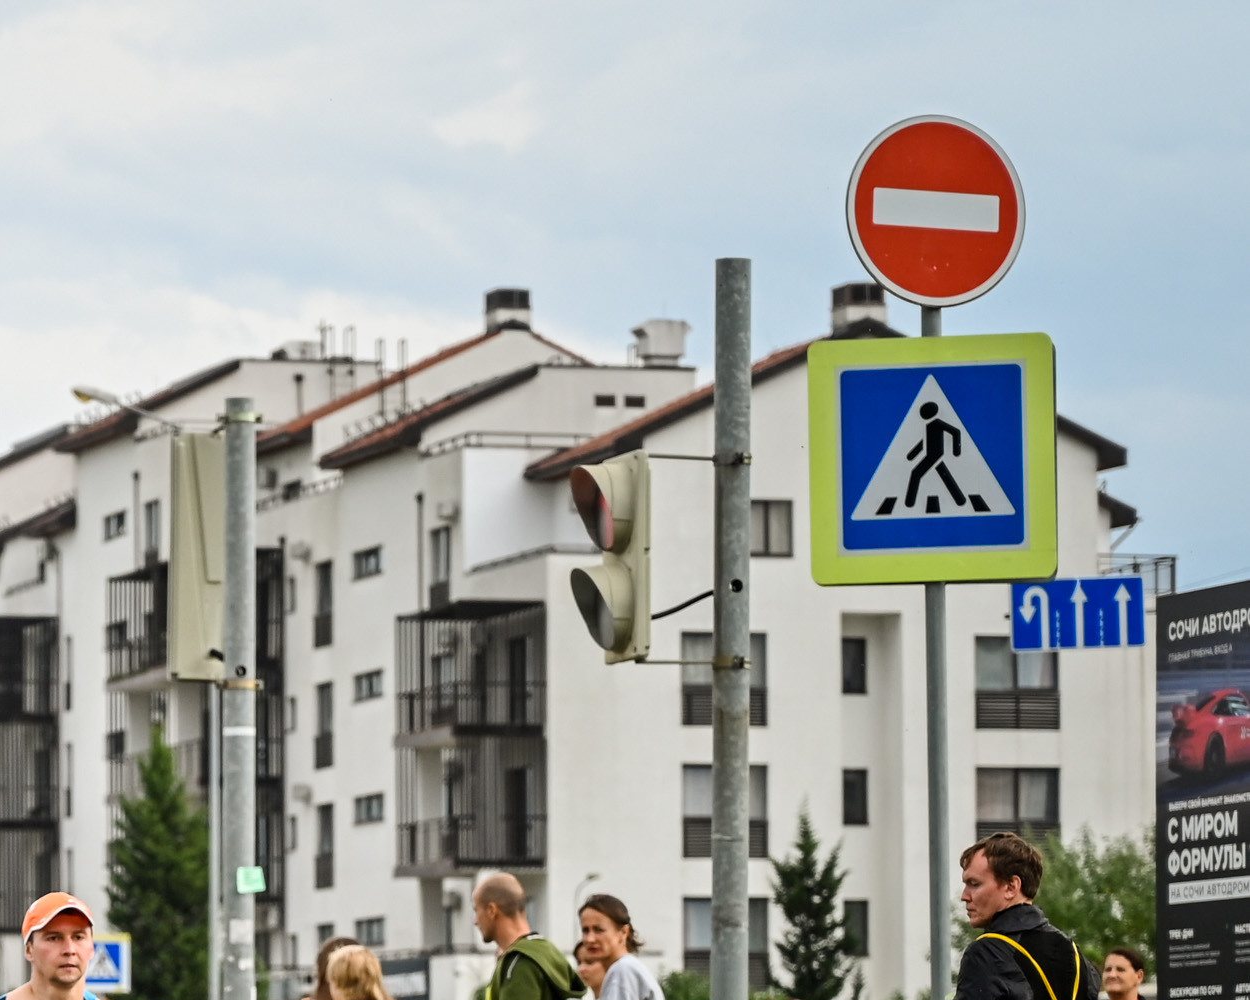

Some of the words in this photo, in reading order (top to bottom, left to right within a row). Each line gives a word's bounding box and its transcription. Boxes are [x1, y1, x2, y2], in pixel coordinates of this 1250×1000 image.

[1168, 616, 1200, 641] СОЧИ
[1168, 817, 1179, 844] С
[1182, 810, 1238, 842] МИРОМ
[1168, 842, 1246, 876] ФОРМУЛЫ
[1171, 888, 1181, 898] НА
[1183, 884, 1205, 898] СОЧИ
